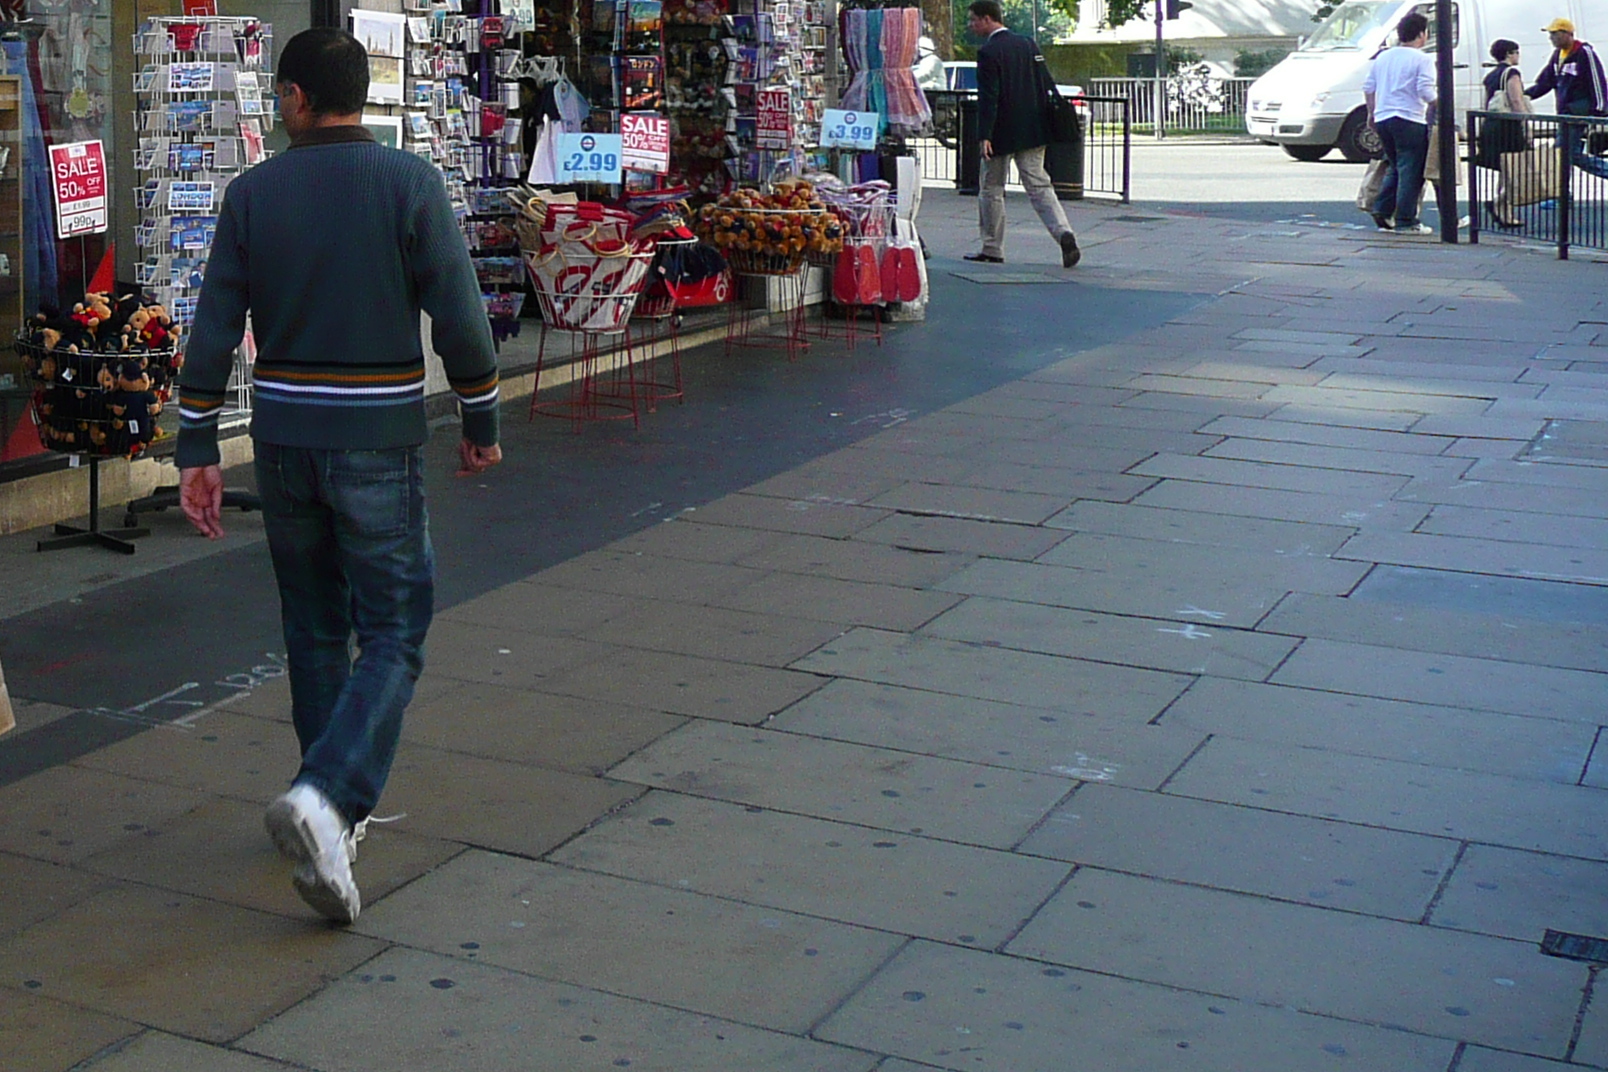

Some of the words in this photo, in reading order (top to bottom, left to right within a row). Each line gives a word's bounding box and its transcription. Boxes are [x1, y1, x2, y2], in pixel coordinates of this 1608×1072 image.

[757, 92, 788, 111] SALE
[622, 116, 668, 137] SALE
[828, 124, 873, 141] £3.99
[622, 133, 649, 150] 50%
[57, 158, 99, 179] SALE
[563, 153, 618, 172] £2.99
[59, 181, 86, 199] 50%
[86, 177, 102, 187] OFF
[73, 215, 93, 228] 99p
